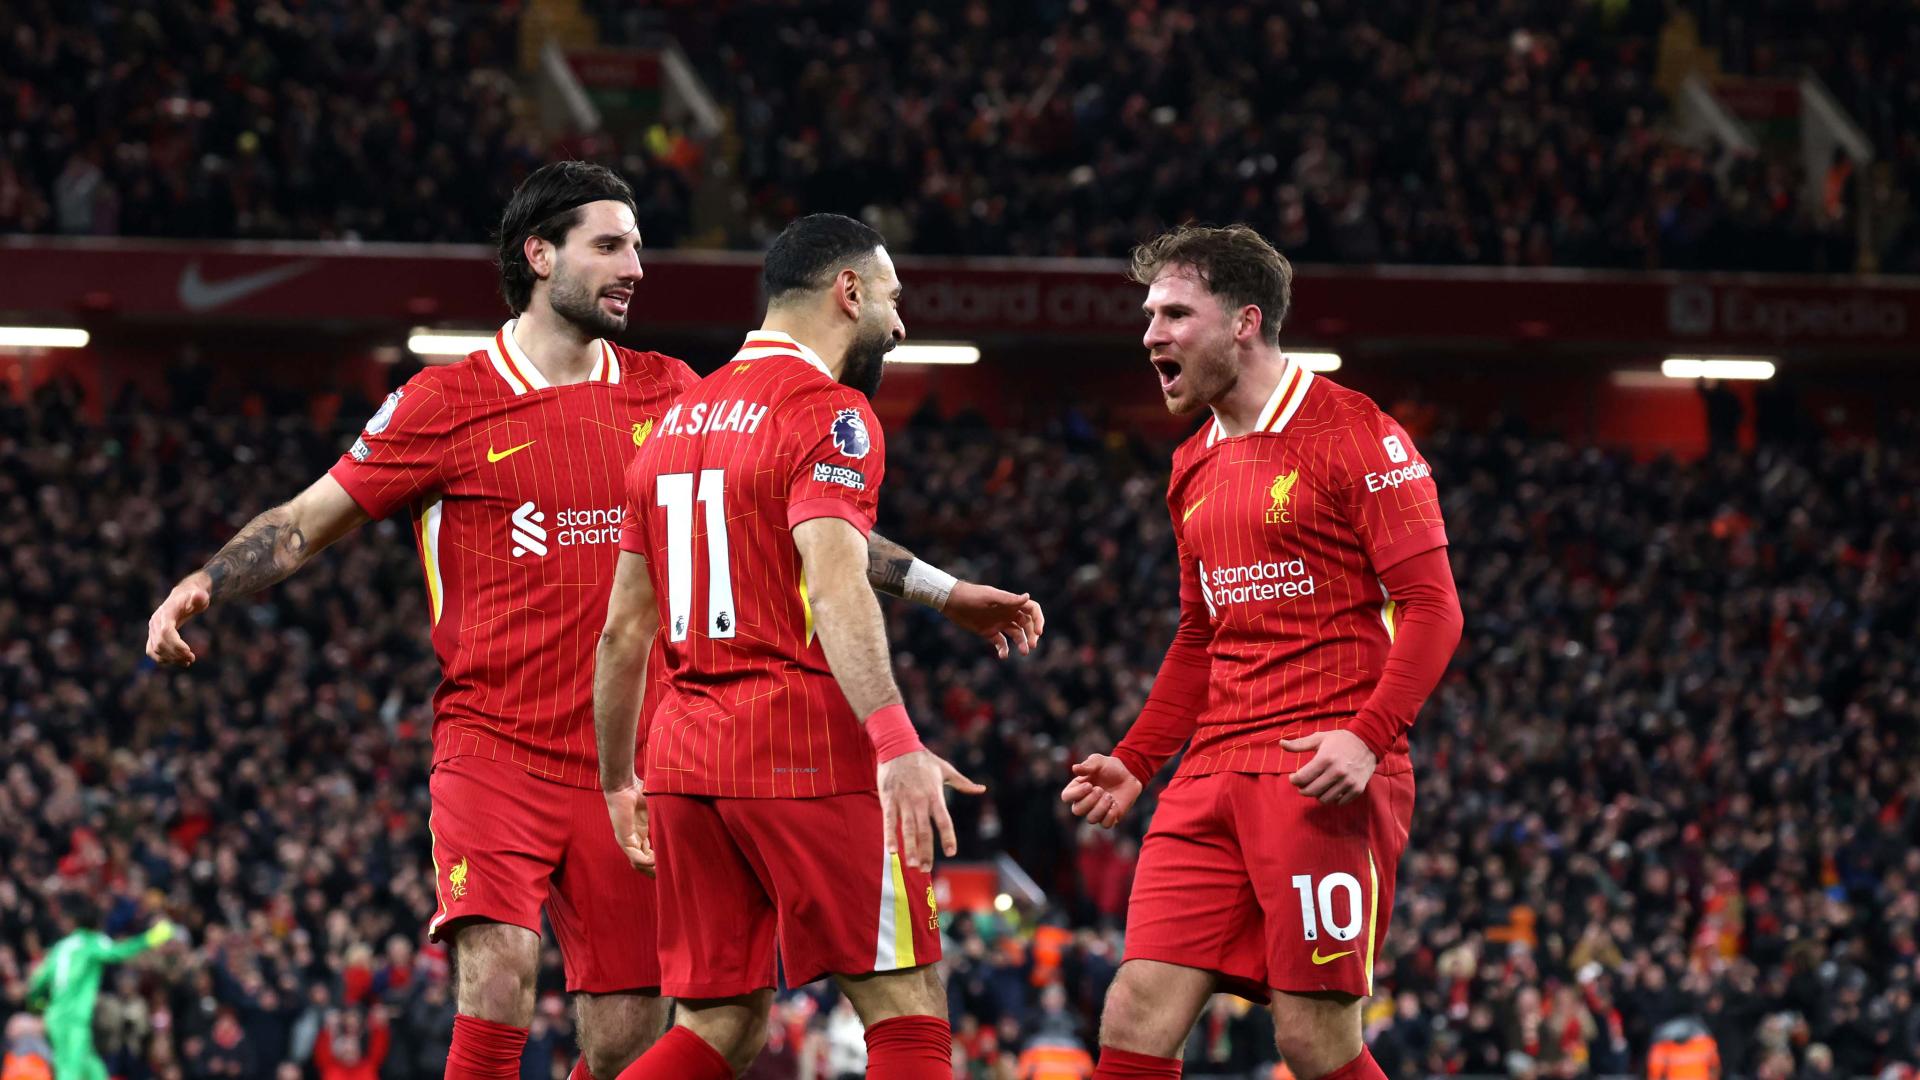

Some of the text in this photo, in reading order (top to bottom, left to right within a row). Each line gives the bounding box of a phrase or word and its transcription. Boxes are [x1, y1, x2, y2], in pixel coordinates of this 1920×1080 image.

[813, 472, 829, 482] for
[814, 463, 861, 482] No room
[1364, 460, 1430, 493] Expedia
[656, 469, 736, 643] 11
[1212, 557, 1305, 586] standard
[1215, 575, 1315, 606] chartered
[1292, 872, 1363, 941] 10
